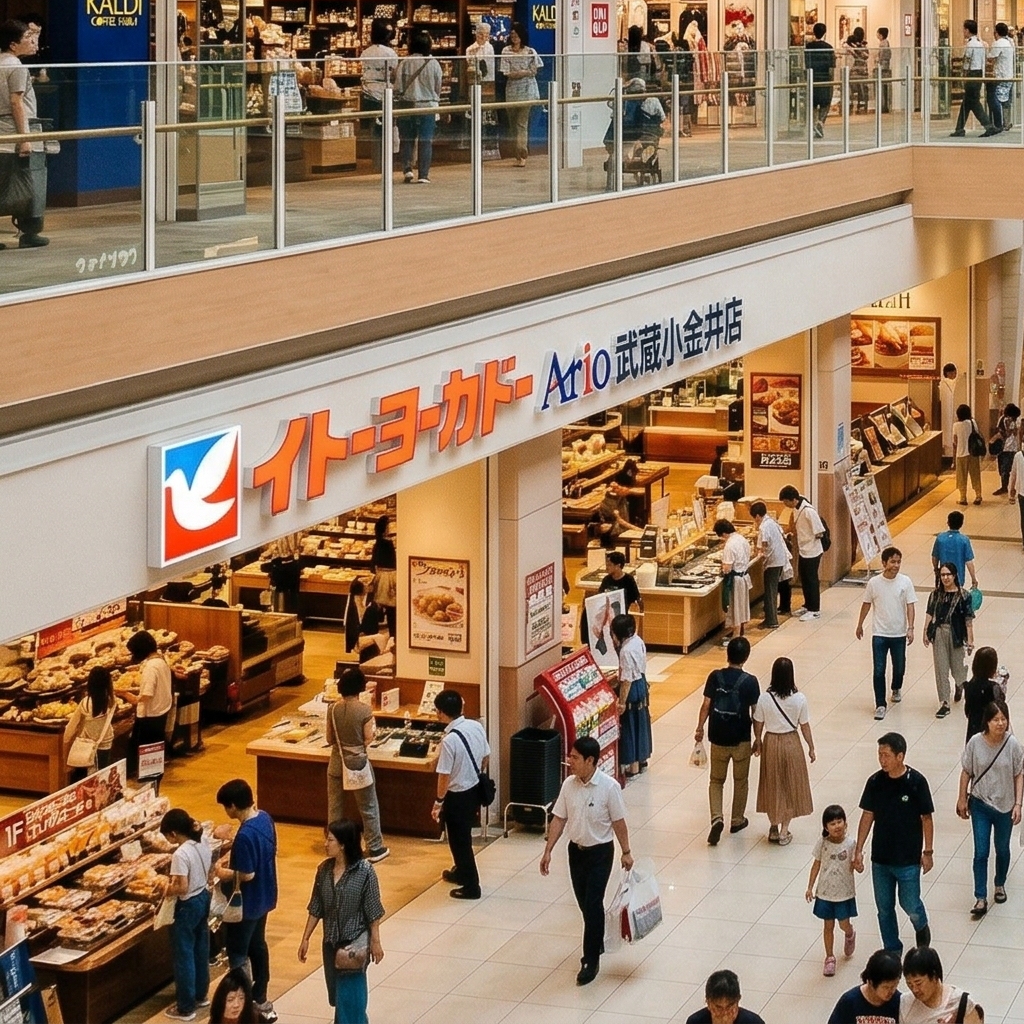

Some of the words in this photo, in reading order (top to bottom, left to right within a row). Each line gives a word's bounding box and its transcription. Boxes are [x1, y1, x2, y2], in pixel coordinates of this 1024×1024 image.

[250, 354, 533, 517] イトーヨーカドー
[541, 341, 611, 411] Ario
[614, 296, 743, 384] 武蔵小金井店
